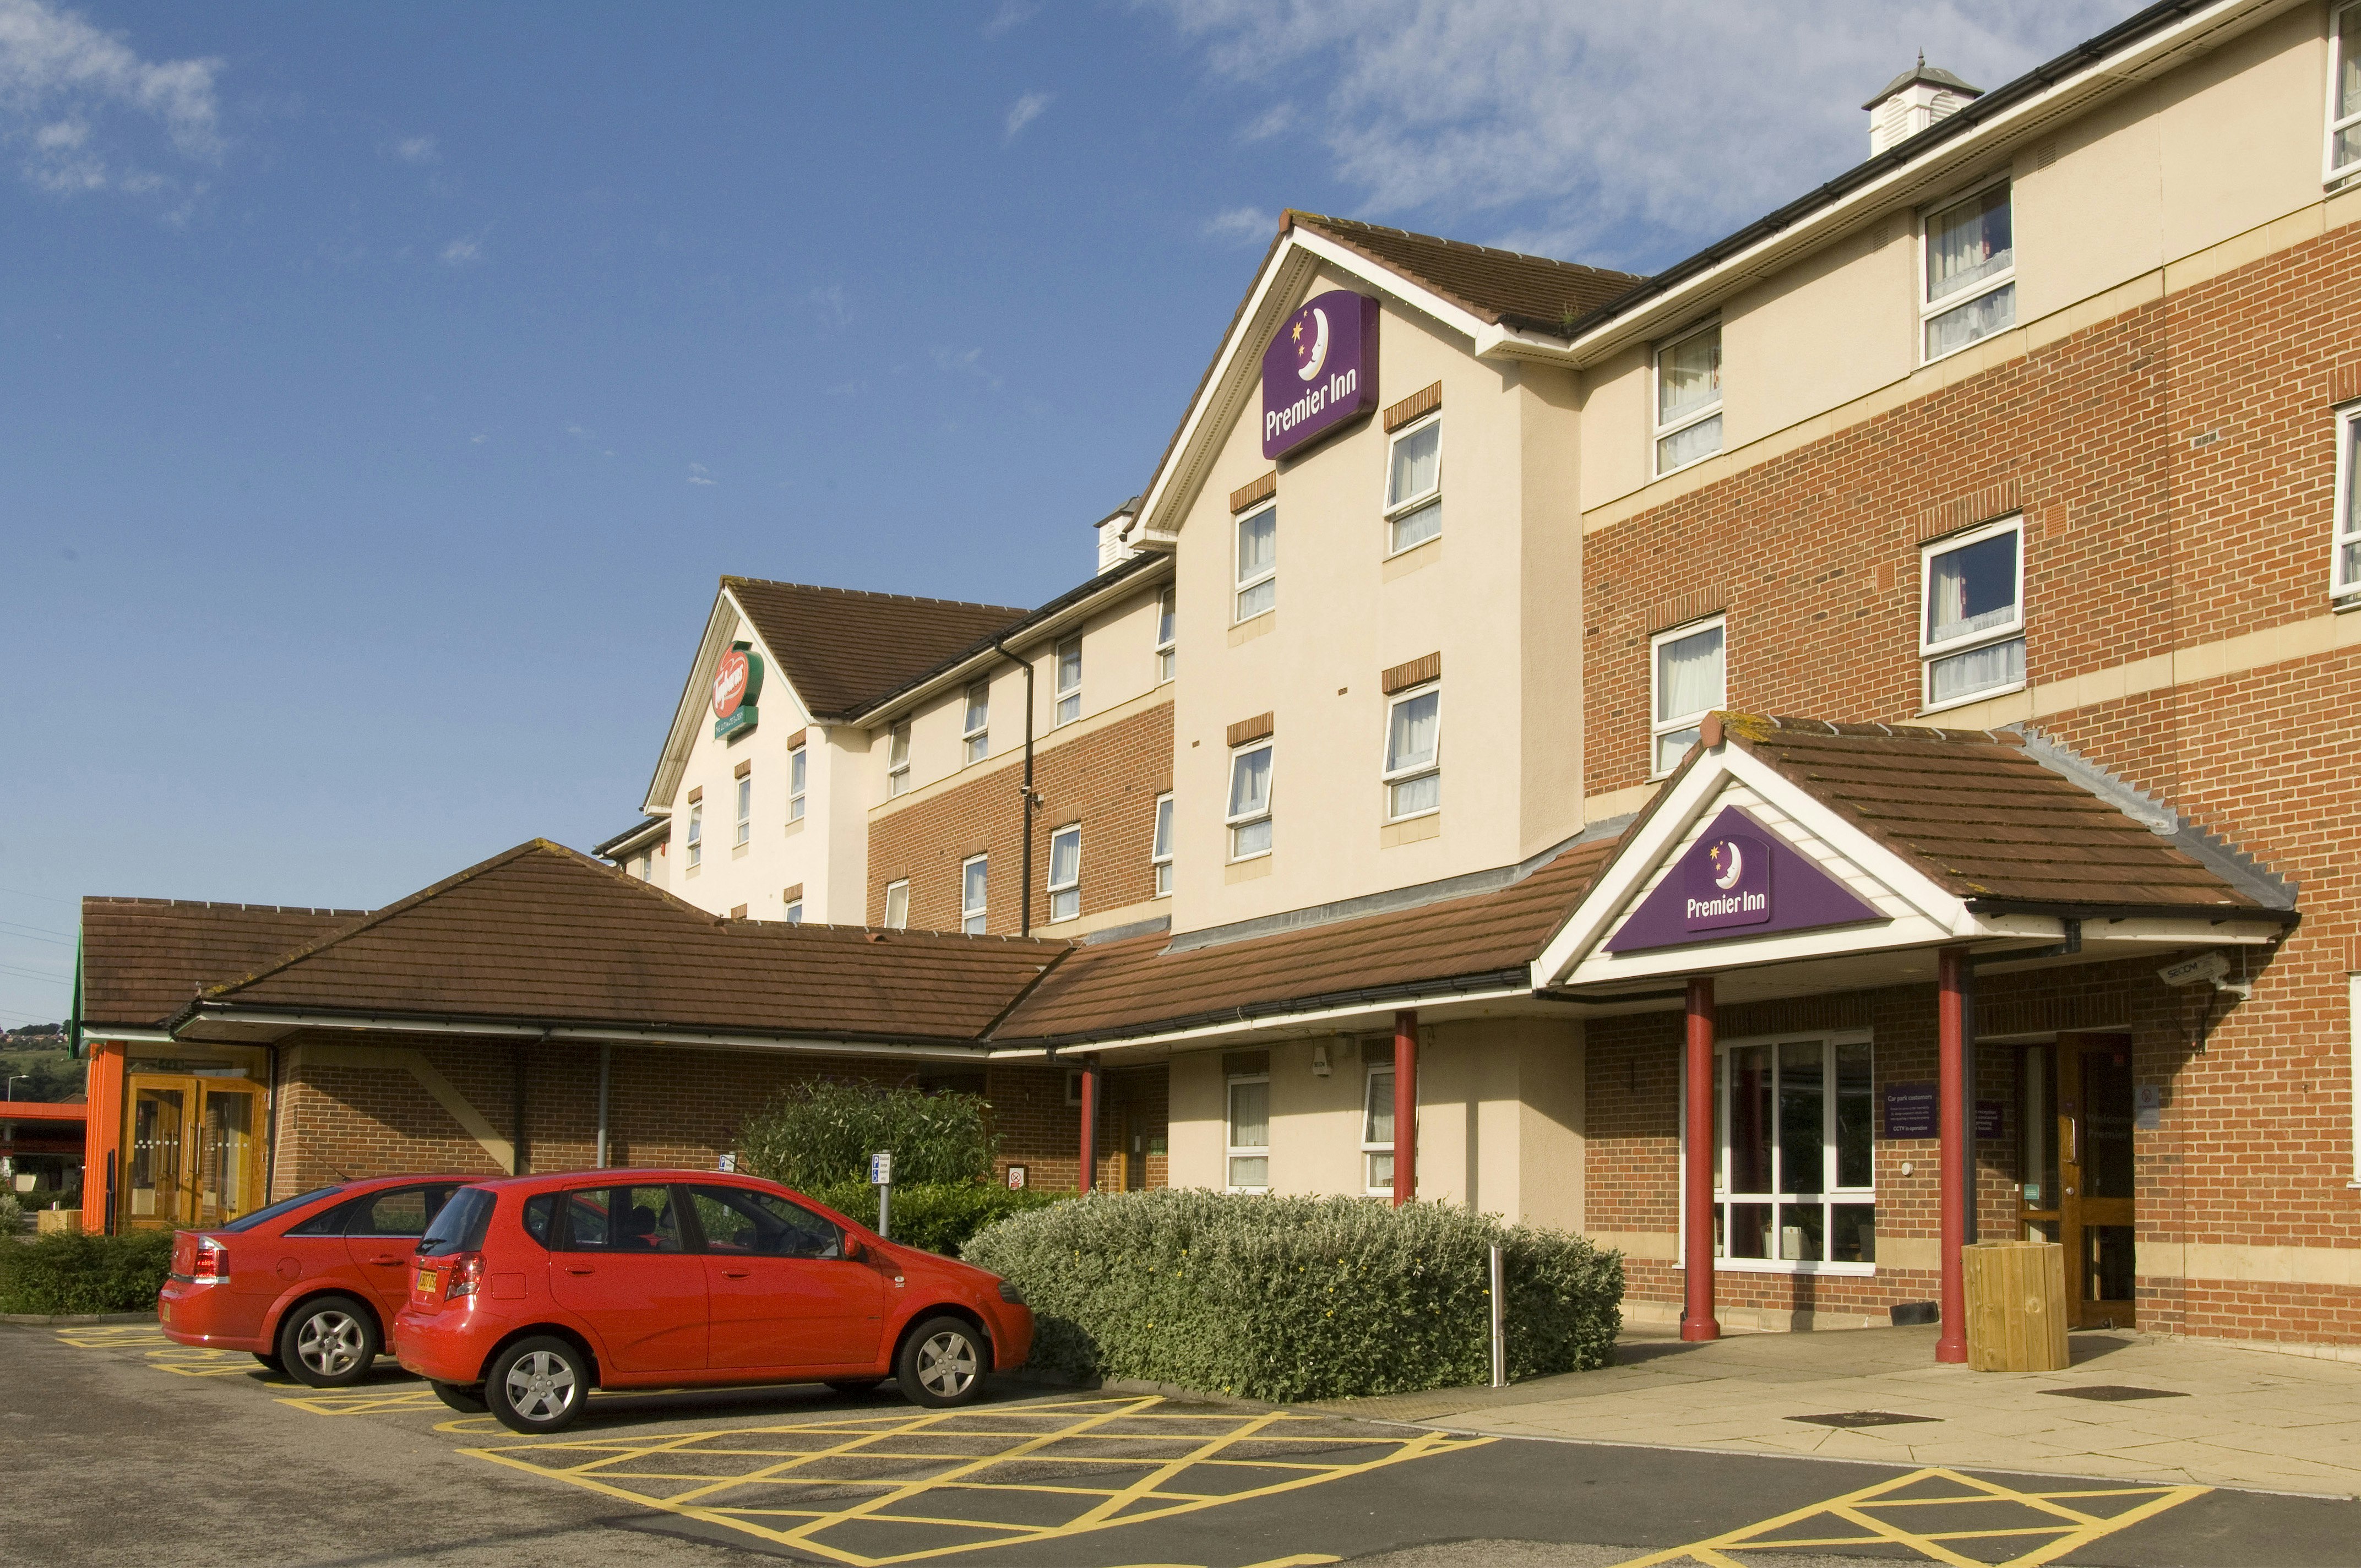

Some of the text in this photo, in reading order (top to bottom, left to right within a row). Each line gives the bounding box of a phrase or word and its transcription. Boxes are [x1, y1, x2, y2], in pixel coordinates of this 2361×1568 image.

[1266, 368, 1357, 442] Premier Inn
[1687, 891, 1765, 919] Premier Inn
[2168, 962, 2198, 978] SECOM
